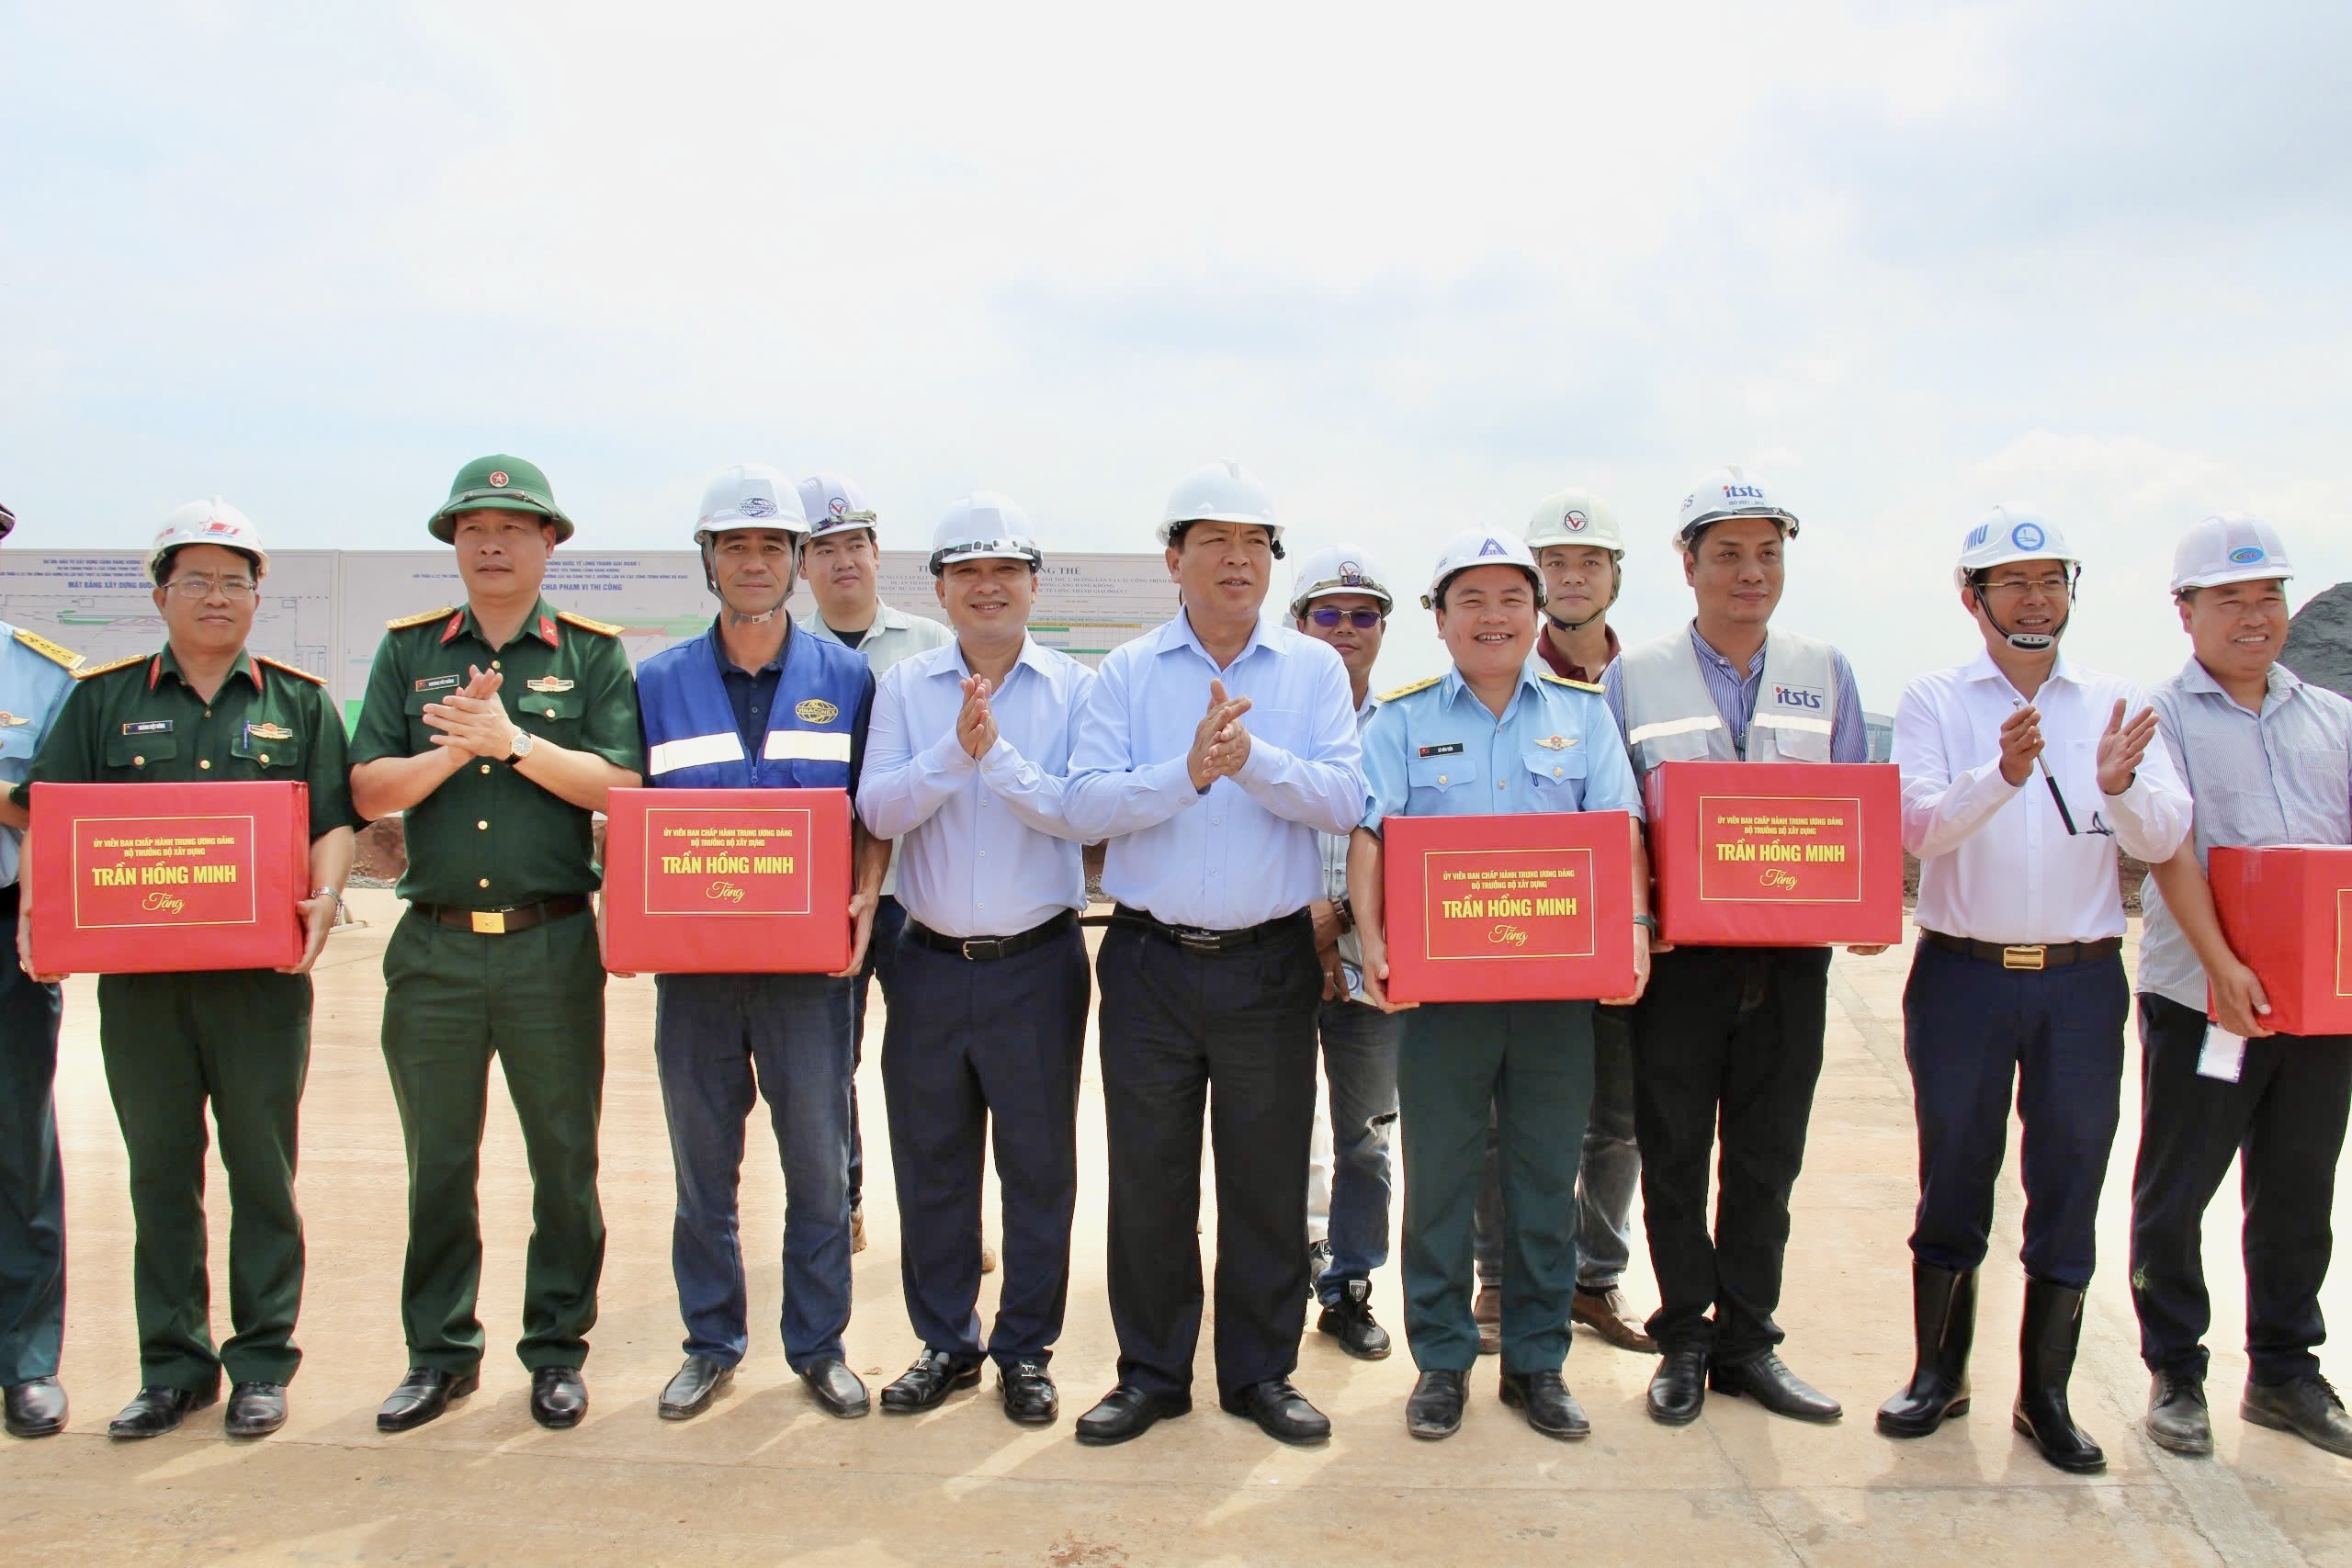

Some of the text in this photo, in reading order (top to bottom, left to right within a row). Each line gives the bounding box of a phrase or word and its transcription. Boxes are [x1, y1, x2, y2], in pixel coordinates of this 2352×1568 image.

[1723, 485, 1764, 499] itsts
[1775, 686, 1822, 709] itsts
[797, 707, 836, 716] VINACONEX
[1741, 816, 1753, 824] BAN
[1789, 816, 1808, 825] TRUNG
[687, 828, 699, 837] BAN
[737, 828, 756, 837] TRUNG
[1745, 826, 1753, 835] BỘ
[1779, 826, 1786, 835] BỘ
[120, 838, 133, 847] BAN
[175, 836, 196, 846] TRUNG
[691, 838, 700, 848] BỘ
[726, 838, 734, 848] BỘ
[124, 848, 134, 858] BỘ
[164, 847, 173, 857] BỘ
[1716, 839, 1845, 862] TRẦN HỒNG MINH
[662, 851, 793, 874] TRẦN HỒNG MINH
[92, 861, 236, 886] TRẦN HỒNG MINH
[1467, 870, 1480, 880] BAN
[1518, 869, 1538, 878] TRUNG
[1760, 869, 1797, 890] Tặng
[706, 881, 745, 903] Tặng
[1472, 881, 1480, 891] BỘ
[1508, 880, 1516, 890] BỘ
[142, 892, 185, 914] Tặng
[1442, 894, 1577, 918] TRẦN HỒNG MINH
[1488, 925, 1528, 946] Tặng
